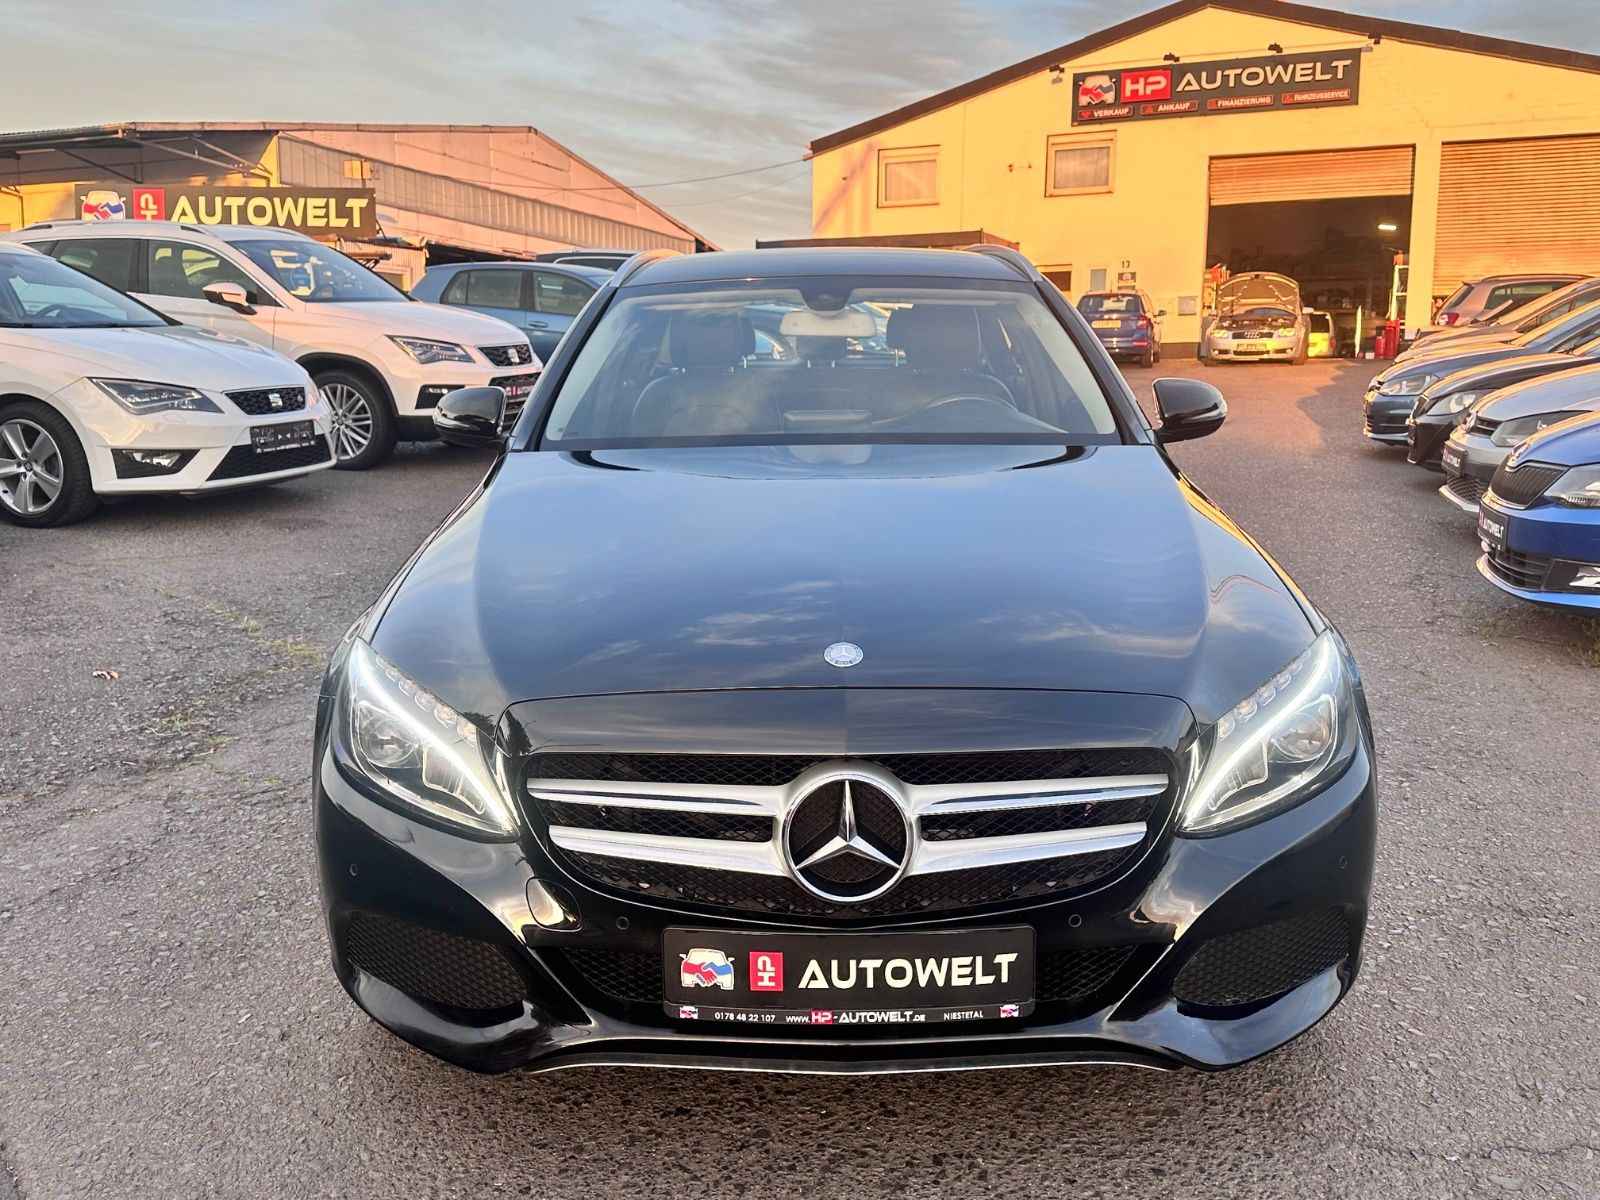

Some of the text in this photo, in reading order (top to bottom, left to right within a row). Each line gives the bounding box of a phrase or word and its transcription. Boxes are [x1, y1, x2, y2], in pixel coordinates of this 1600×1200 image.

[1123, 60, 1352, 97] HP AUTOWELT
[1294, 90, 1348, 101] FAHRZEUGSERVICE
[1217, 96, 1271, 107] FINANZIERUNG
[1158, 102, 1190, 112] ANKAUF
[1093, 108, 1129, 117] VERKAUF
[171, 195, 368, 227] AUTOWELT
[1121, 260, 1131, 269] 13
[757, 953, 1018, 989] HP AUTOWELT
[715, 1012, 776, 1022] 0178 48 22 107
[943, 1011, 984, 1020] NIESTETAL
